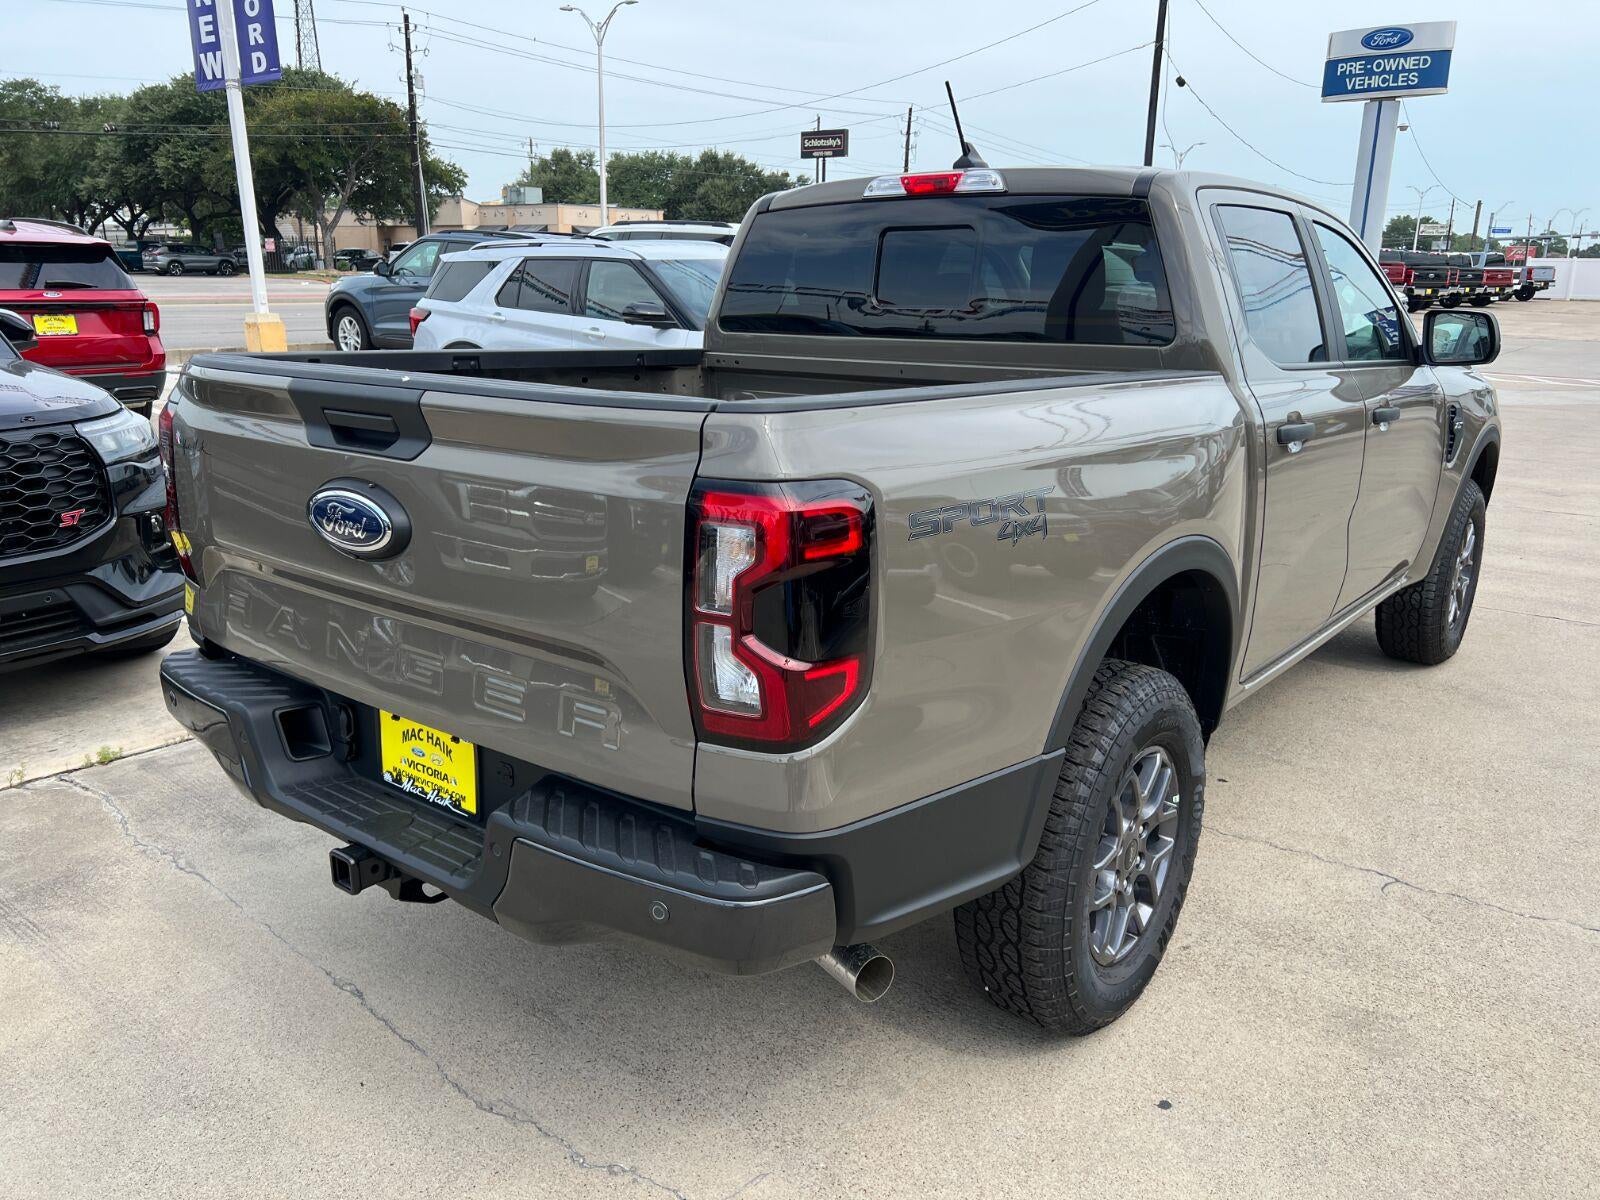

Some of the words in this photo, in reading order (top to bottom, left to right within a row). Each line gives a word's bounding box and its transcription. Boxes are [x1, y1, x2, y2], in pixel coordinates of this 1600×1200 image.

[195, 0, 222, 80] EW
[1371, 32, 1401, 46] Ford
[1337, 55, 1431, 76] PRE-OWNED
[1345, 73, 1419, 90] VEHICLES
[59, 508, 86, 528] ST
[320, 502, 367, 539] Ford
[908, 485, 1056, 541] SPORT
[226, 588, 623, 752] RANGER
[402, 727, 424, 744] MAC
[426, 730, 453, 763] HAIK
[406, 757, 450, 784] VICTORIA
[401, 778, 425, 798] Mac
